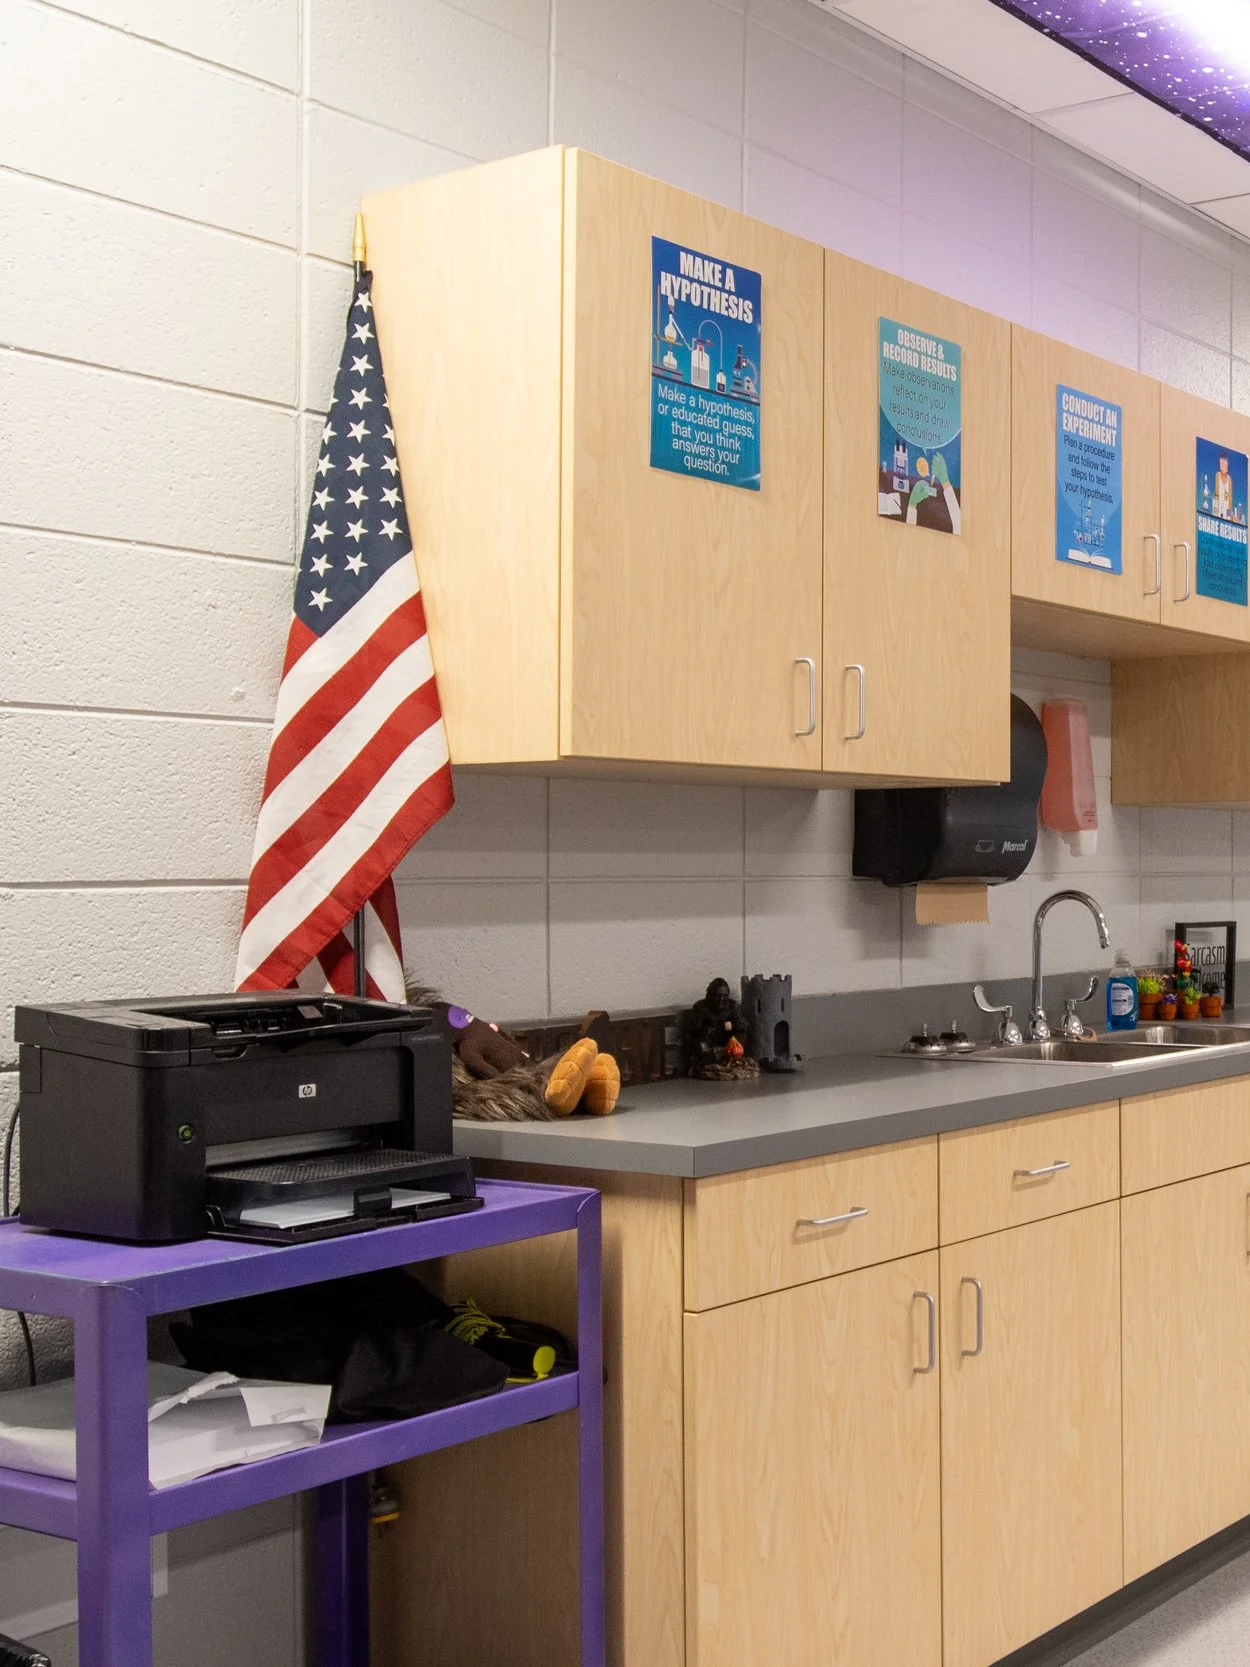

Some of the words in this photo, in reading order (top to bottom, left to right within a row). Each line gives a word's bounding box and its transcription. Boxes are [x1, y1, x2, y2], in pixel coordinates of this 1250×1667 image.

[680, 251, 722, 288] MAKE
[725, 268, 735, 292] A
[661, 271, 753, 324] HYPOTHESIS
[883, 341, 919, 368] RECORD
[920, 355, 957, 381] RESULTS
[897, 328, 937, 357] OBSERVE
[937, 343, 945, 361] &
[884, 361, 905, 378] Make
[658, 384, 686, 404] Make
[689, 396, 696, 407] a
[699, 394, 755, 424] hypothesis,
[893, 384, 916, 400] reflect
[918, 394, 929, 405] on
[930, 398, 947, 410] your
[1062, 392, 1105, 424] CONDUCT
[1106, 408, 1117, 429] AN
[658, 403, 668, 415] or
[672, 407, 719, 429] educated
[723, 421, 755, 440] guess,
[672, 421, 691, 439] that
[695, 429, 713, 444] you
[716, 433, 741, 451] think
[1062, 412, 1117, 448] EXPERIMENT
[672, 438, 715, 458] answers
[718, 449, 740, 465] your
[1064, 434, 1078, 448] Plan
[1083, 444, 1115, 461] procedure
[684, 455, 730, 476] question.
[1199, 515, 1219, 536] SHARE
[1220, 521, 1248, 544] RESULTS
